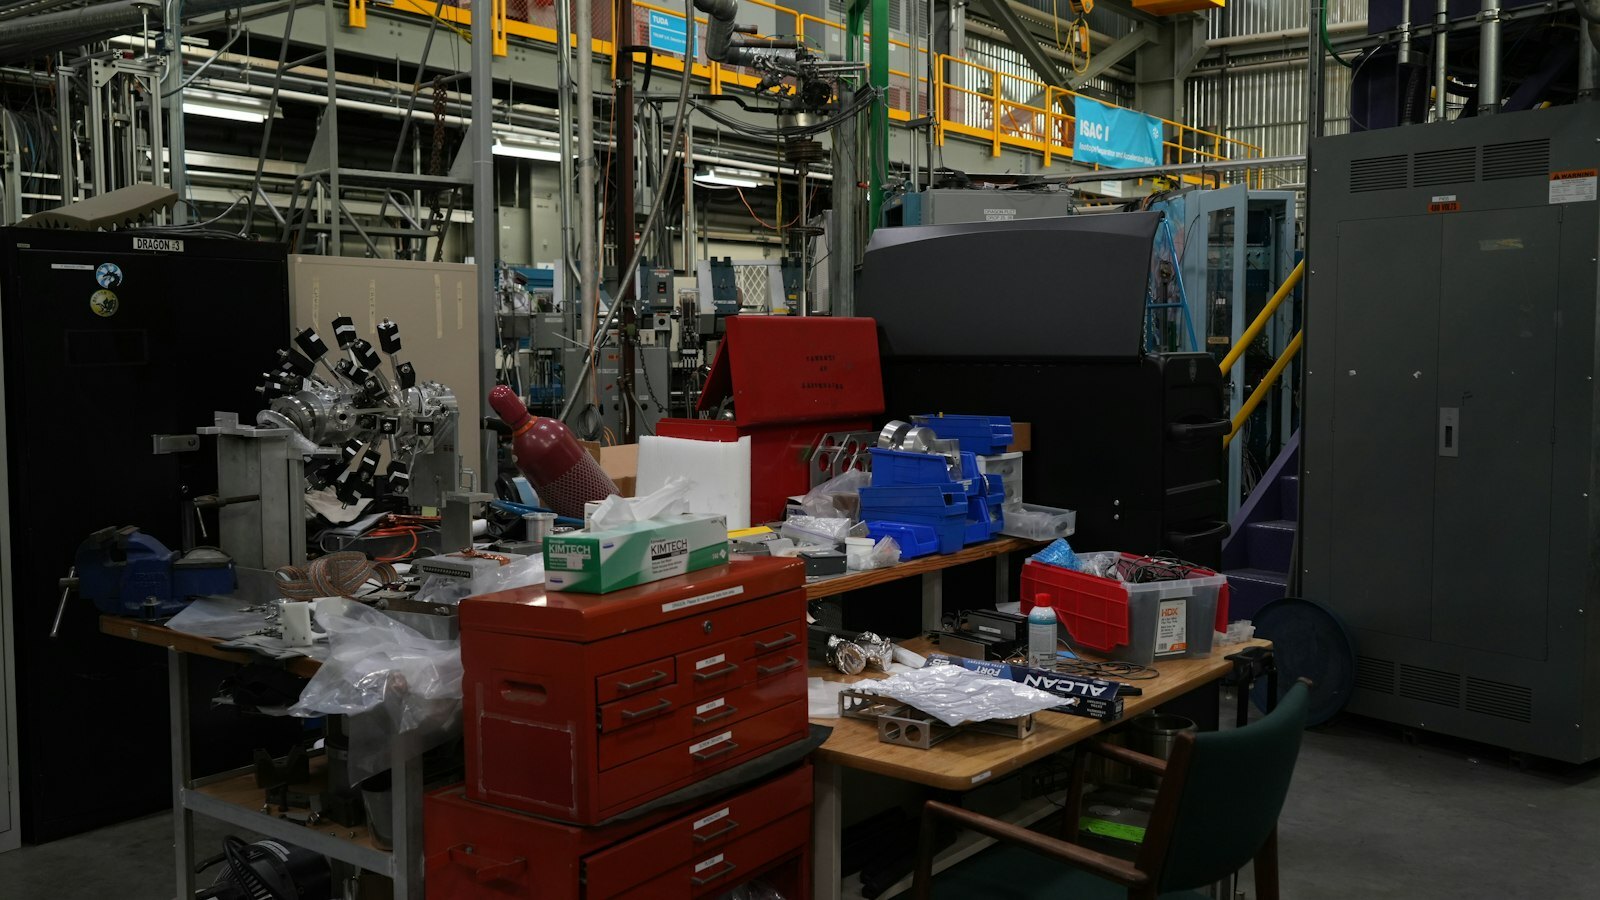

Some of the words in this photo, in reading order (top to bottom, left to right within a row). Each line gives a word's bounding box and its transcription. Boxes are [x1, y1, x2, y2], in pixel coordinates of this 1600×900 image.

[652, 15, 669, 26] TUDA
[1080, 120, 1102, 140] ISAC
[1104, 126, 1110, 142] I
[1561, 171, 1595, 179] WARNING
[1442, 202, 1457, 210] VOLTS
[137, 239, 170, 250] DRAGON
[549, 544, 591, 555] KIMTECH
[651, 539, 688, 556] KIMTECH
[1162, 607, 1178, 617] HDX
[976, 665, 1002, 678] FORT
[1023, 673, 1108, 697] ALCAN
